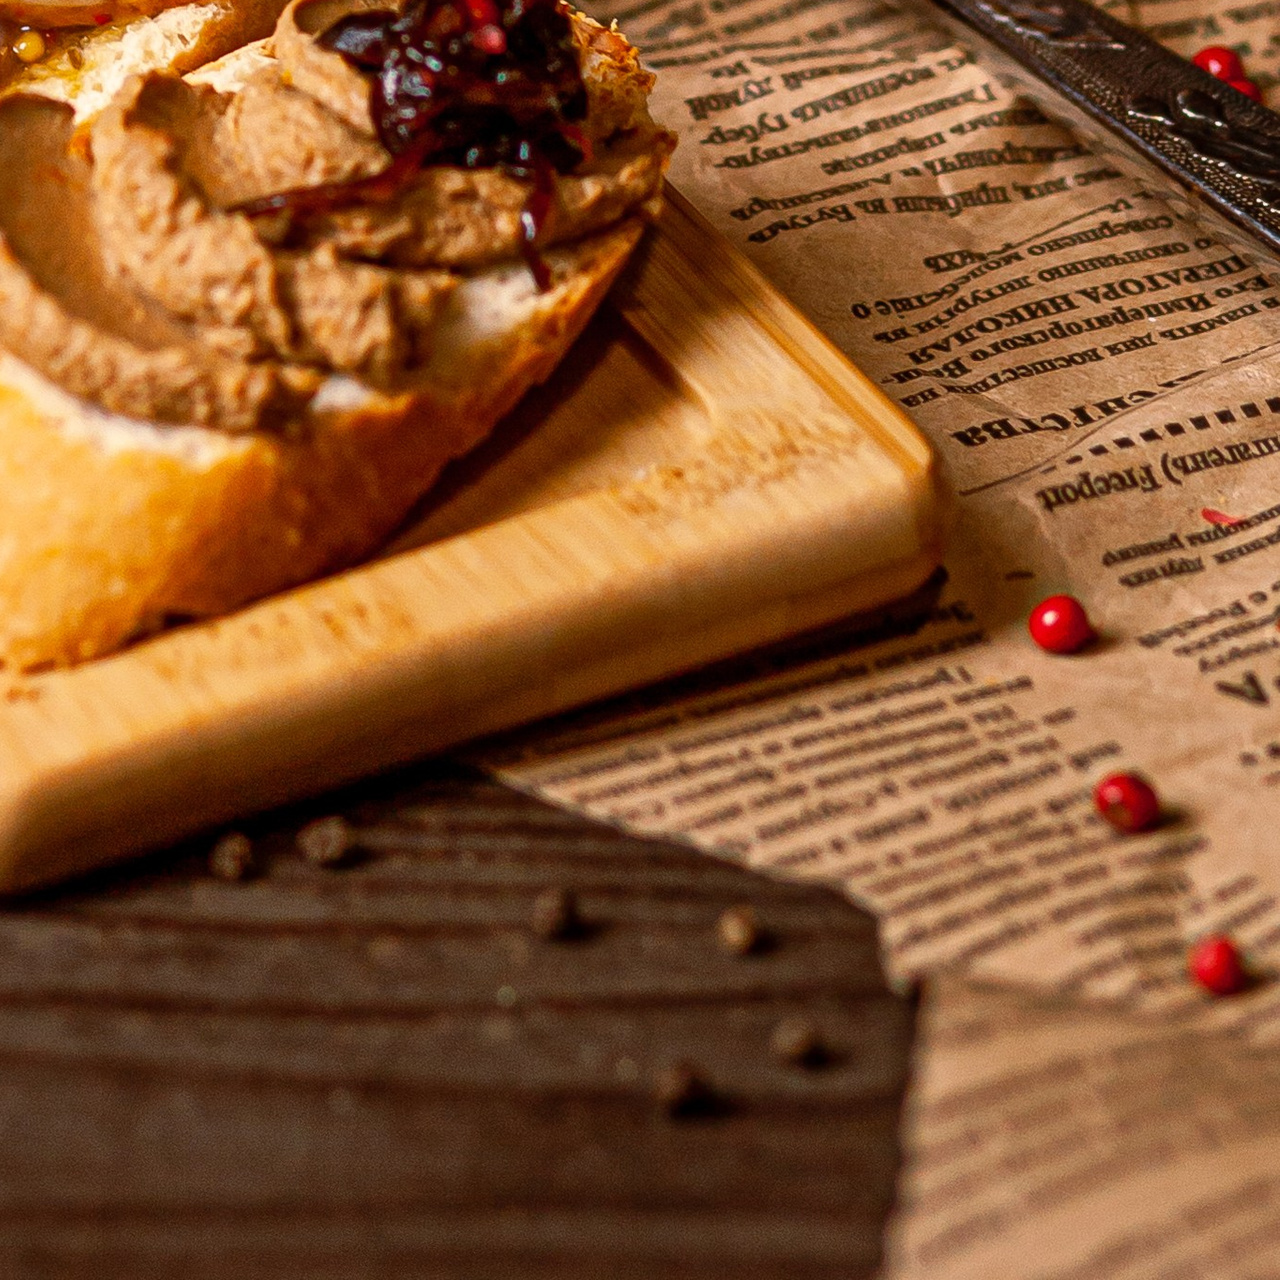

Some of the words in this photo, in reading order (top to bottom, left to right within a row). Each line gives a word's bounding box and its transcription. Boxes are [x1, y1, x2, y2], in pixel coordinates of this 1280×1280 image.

[1075, 255, 1248, 304] ПЕРАТОРА
[1214, 274, 1272, 300] Его
[904, 294, 1080, 365] НИКОЛАЯ
[970, 293, 1215, 362] Императорского
[1103, 331, 1157, 356] дня
[1158, 303, 1261, 341] память
[899, 387, 941, 408] на
[1035, 464, 1162, 512] Freeport
